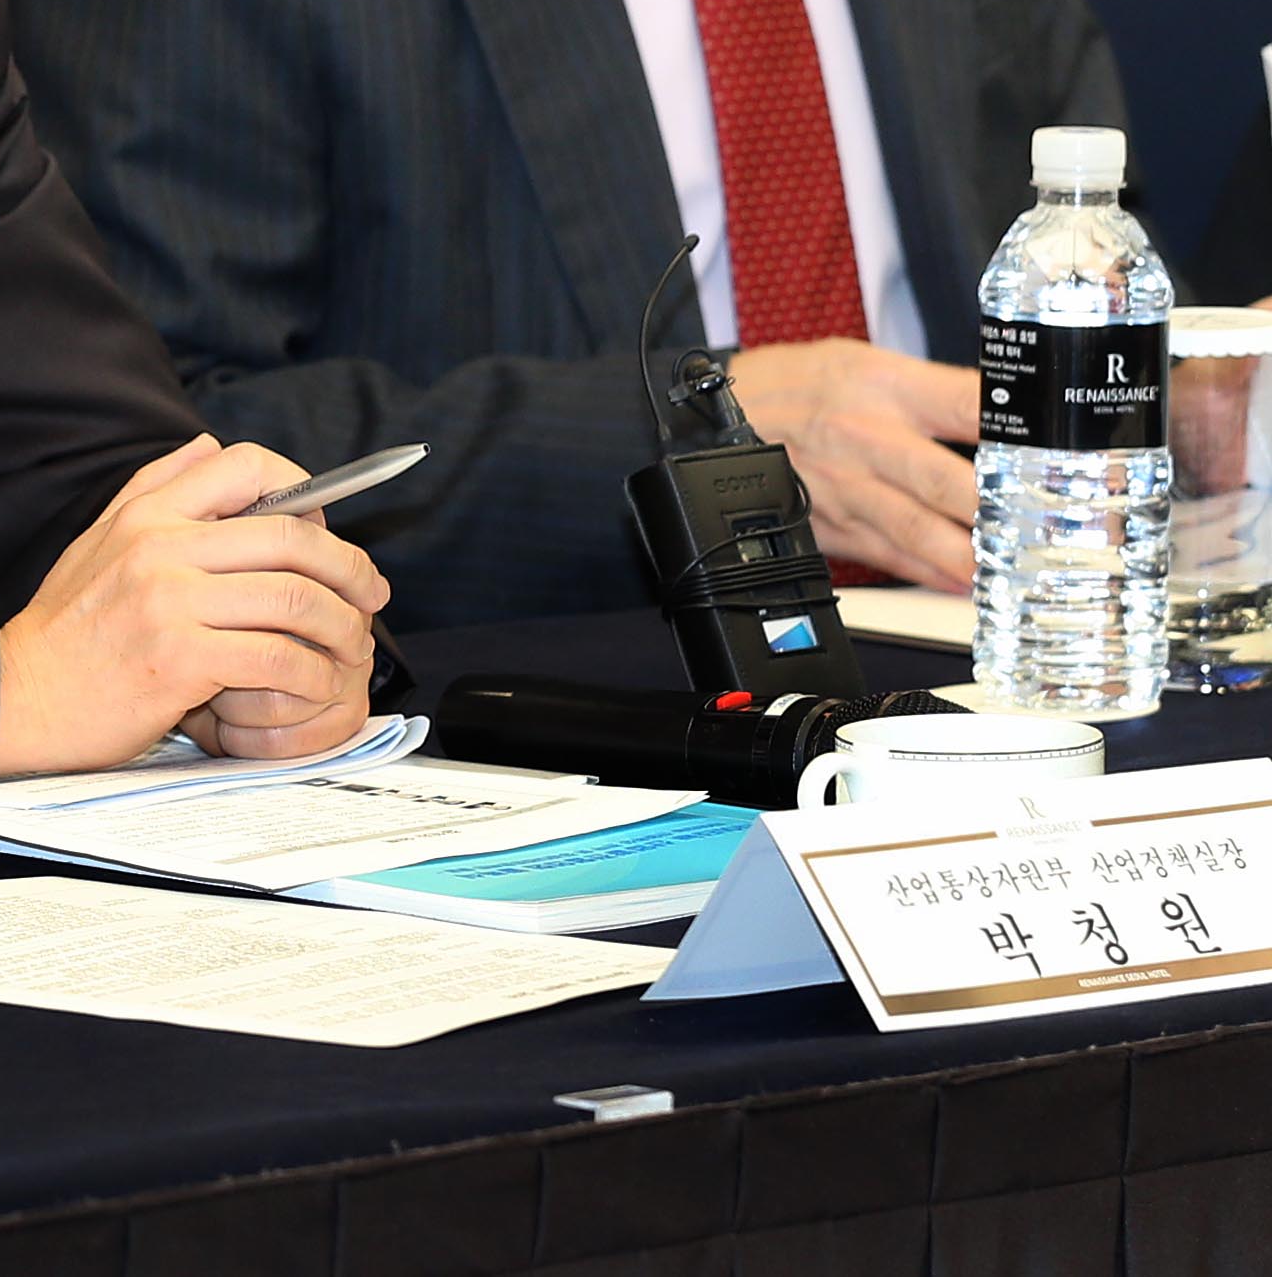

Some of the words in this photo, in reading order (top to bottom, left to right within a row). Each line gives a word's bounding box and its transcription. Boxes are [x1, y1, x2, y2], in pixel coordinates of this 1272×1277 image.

[1106, 353, 1130, 384] R
[1064, 386, 1158, 404] RENAISSANCE
[887, 858, 1072, 907] 산업통상자원부
[1090, 838, 1248, 884] 산업정책실장
